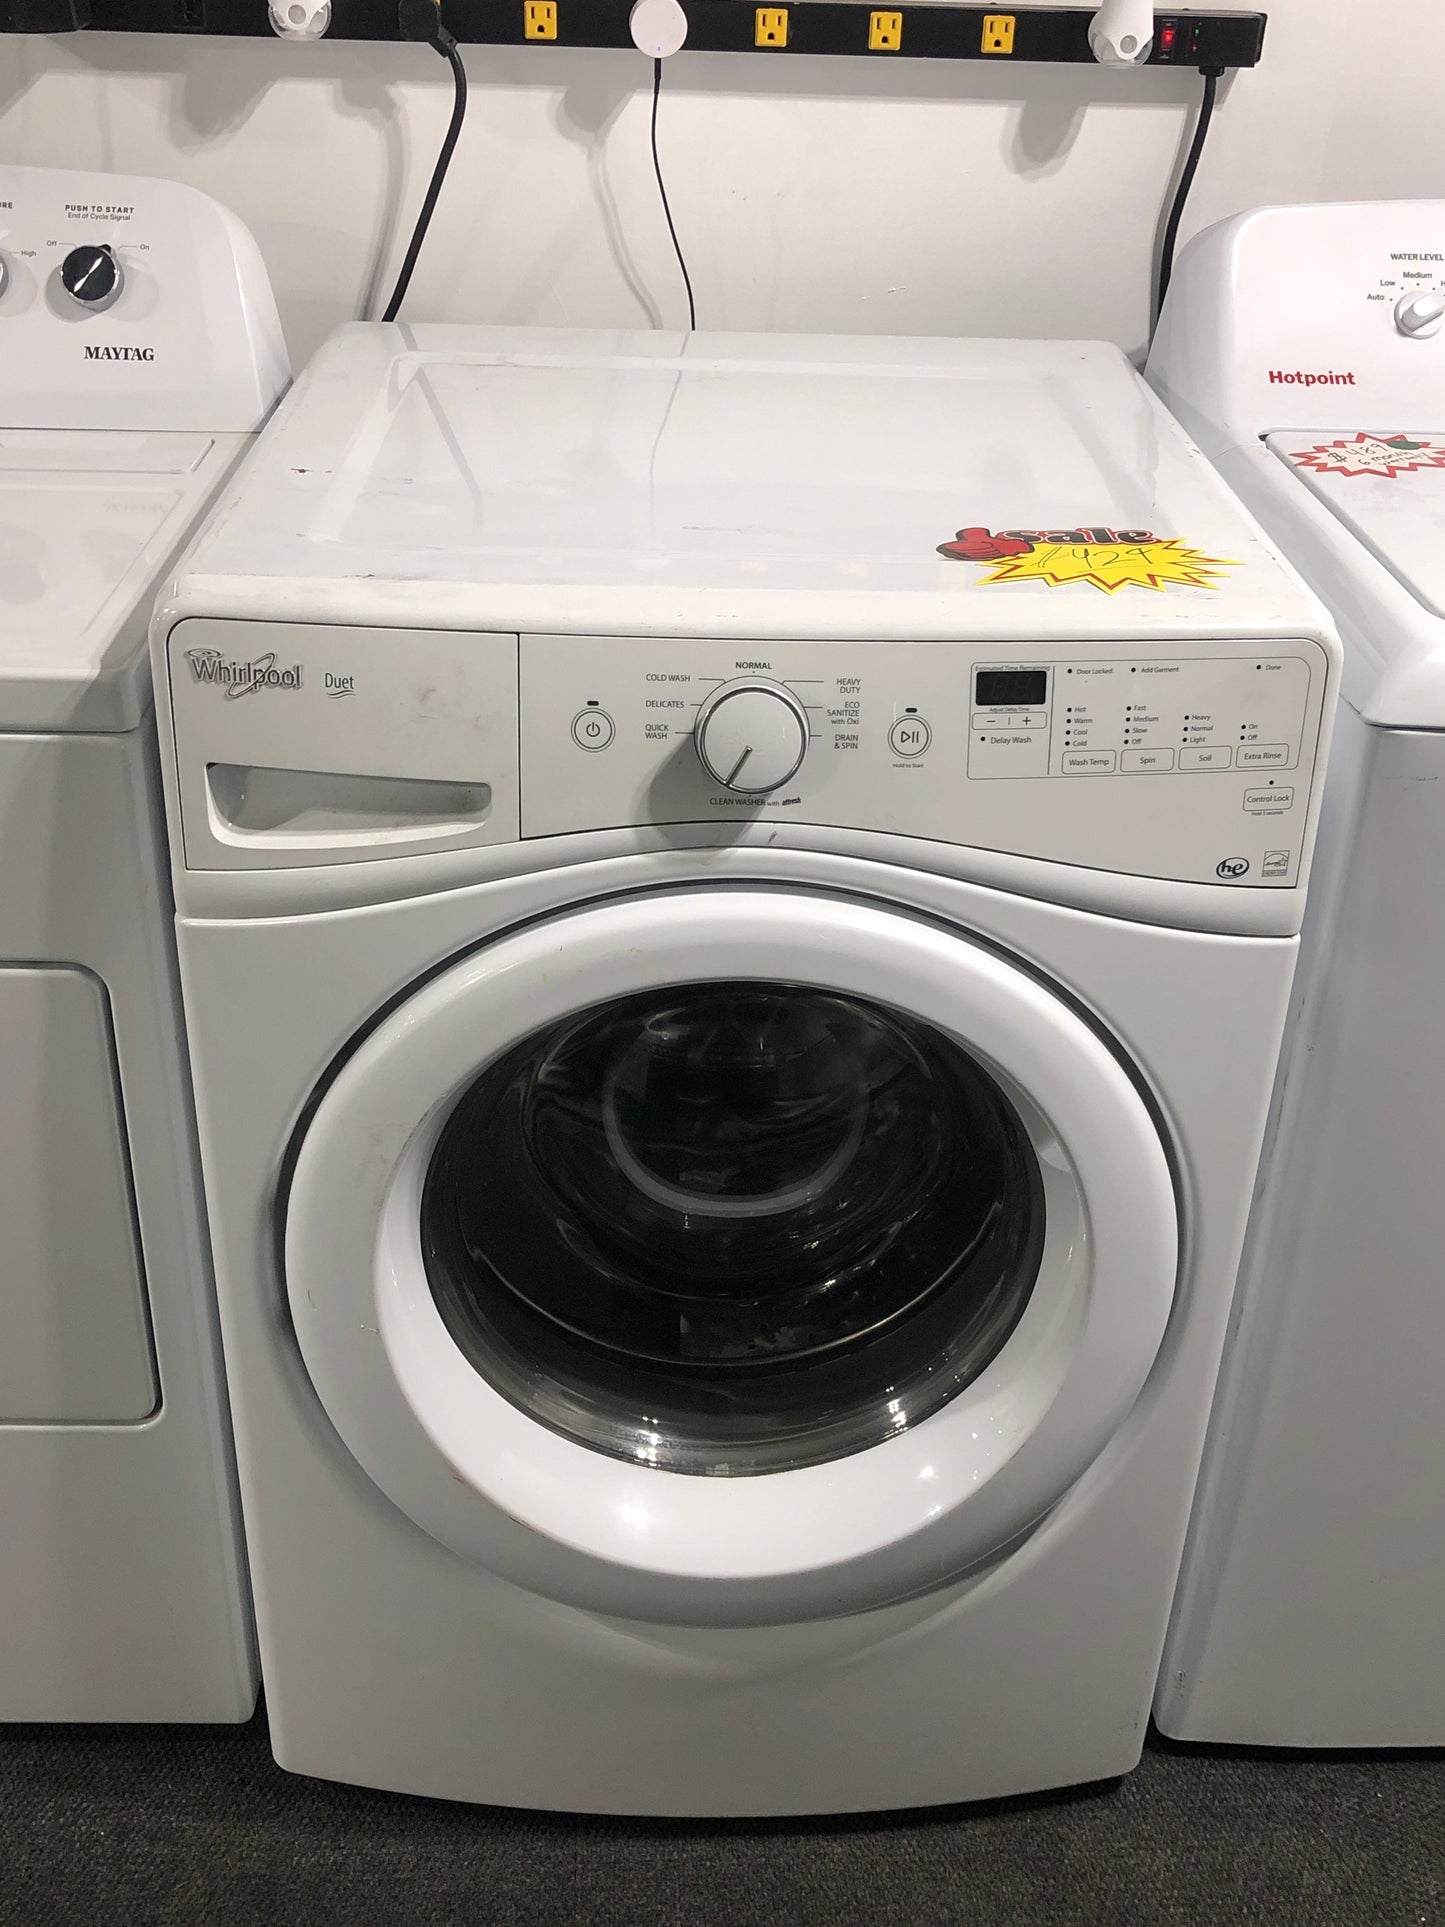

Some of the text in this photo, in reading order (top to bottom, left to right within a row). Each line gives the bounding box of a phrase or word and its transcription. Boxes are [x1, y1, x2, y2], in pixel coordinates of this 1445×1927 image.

[65, 204, 134, 214] PUSH TO START
[90, 213, 109, 221] Cycle
[110, 214, 131, 222] Signal
[20, 250, 37, 258] High
[1390, 253, 1418, 261] WATER
[1402, 271, 1433, 279] Medium
[1380, 279, 1396, 287] Low
[1367, 293, 1385, 301] Auto
[84, 346, 155, 361] MAYTAG
[1268, 370, 1356, 387] Hotpoint
[1003, 527, 1159, 544] sale
[735, 661, 772, 670] NORMAL
[191, 657, 355, 690] Whirlpool Duet
[1092, 667, 1113, 675] Locked
[645, 673, 691, 682] COLD WASH
[836, 678, 861, 686] HEAVY
[839, 686, 861, 694] DUTY
[645, 700, 685, 708] DELICATES
[844, 701, 860, 709] ECO
[827, 709, 860, 717] SANITIZE
[846, 717, 859, 725] Oxi
[645, 724, 669, 732] QUICK
[645, 731, 668, 740] WASH
[835, 733, 859, 742] DRAIN
[990, 735, 1032, 745] Delay Wash
[841, 742, 858, 750] SPIN
[1198, 754, 1212, 762] Soil
[1244, 751, 1282, 760] Extra Rinse
[1089, 758, 1110, 767] Temp
[1140, 757, 1156, 765] Spin
[709, 797, 734, 806] CLEAN
[735, 798, 766, 806] WASHER
[1246, 794, 1290, 804] Control Lock
[1220, 860, 1243, 875] he
